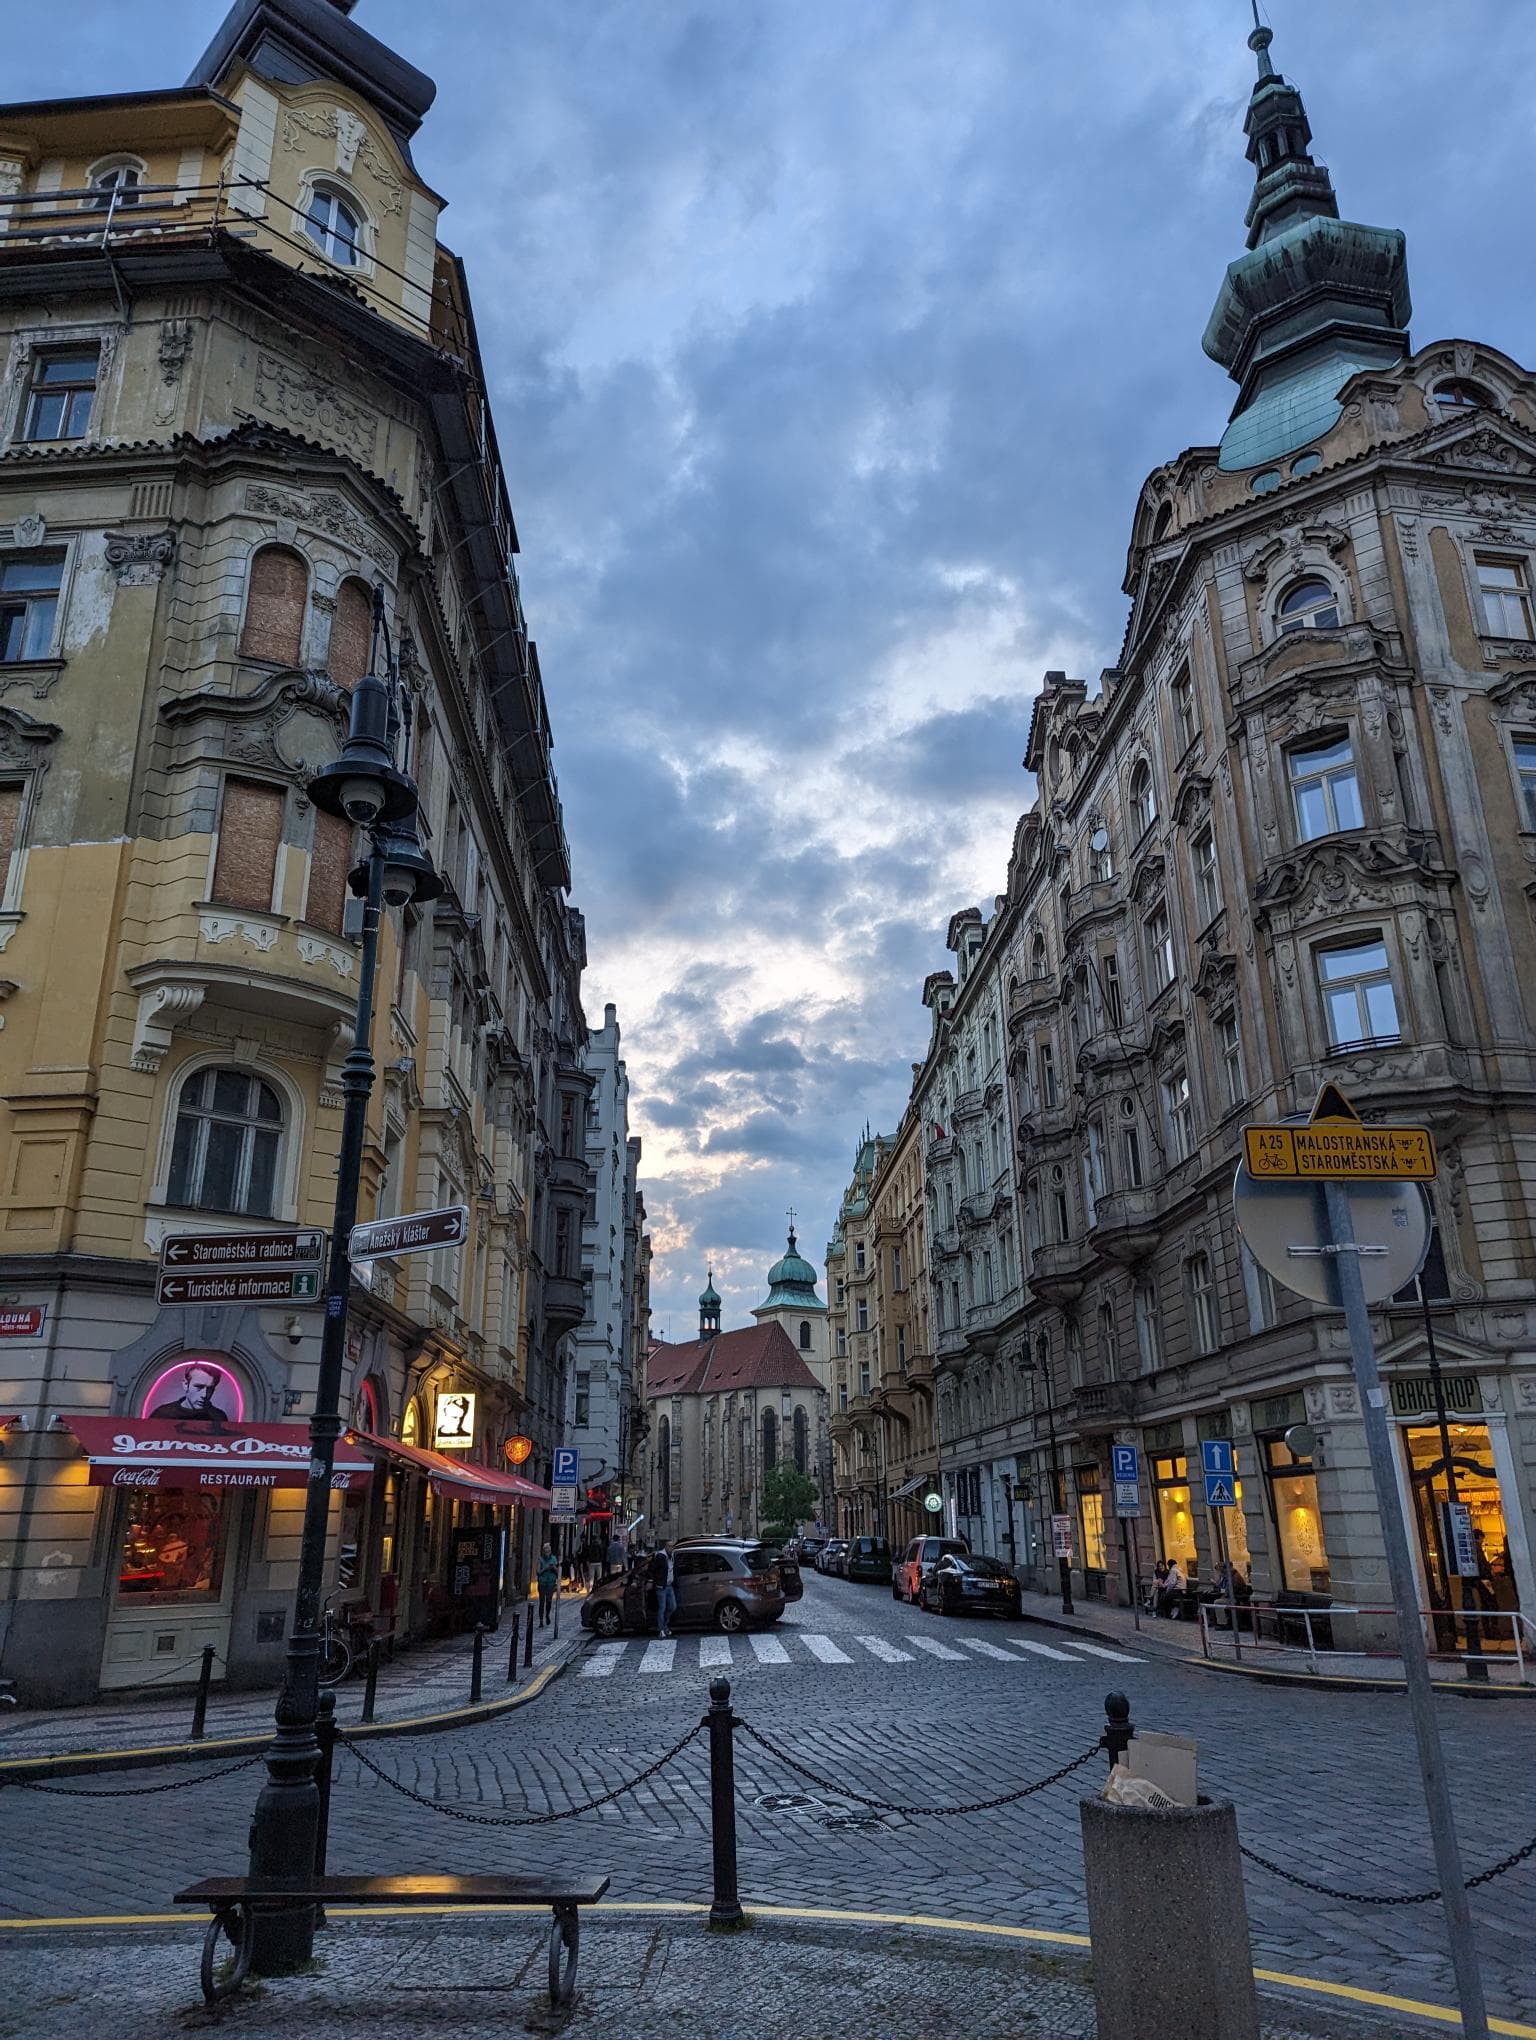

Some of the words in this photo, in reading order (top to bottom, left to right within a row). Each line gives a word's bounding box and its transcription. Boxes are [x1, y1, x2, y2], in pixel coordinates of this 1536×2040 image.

[1259, 1135, 1268, 1149] A
[1270, 1135, 1283, 1149] 25
[1297, 1134, 1396, 1151] MALOSTRANSKÁ
[1417, 1138, 1425, 1151] 2
[1302, 1153, 1398, 1170] STAROMĚSTSKÁ
[1421, 1157, 1428, 1170] 1
[370, 1229, 401, 1249] Anežský
[403, 1225, 430, 1243] klášter
[193, 1242, 256, 1260] Staroměstská
[259, 1244, 294, 1257] radnice
[187, 1278, 236, 1297] Turistické
[238, 1278, 290, 1295] informace
[1396, 1379, 1475, 1410] BAKEHOP
[112, 1434, 229, 1454] James
[559, 1452, 574, 1474] P
[1118, 1450, 1132, 1471] P
[200, 1474, 277, 1486] RESTAURANT
